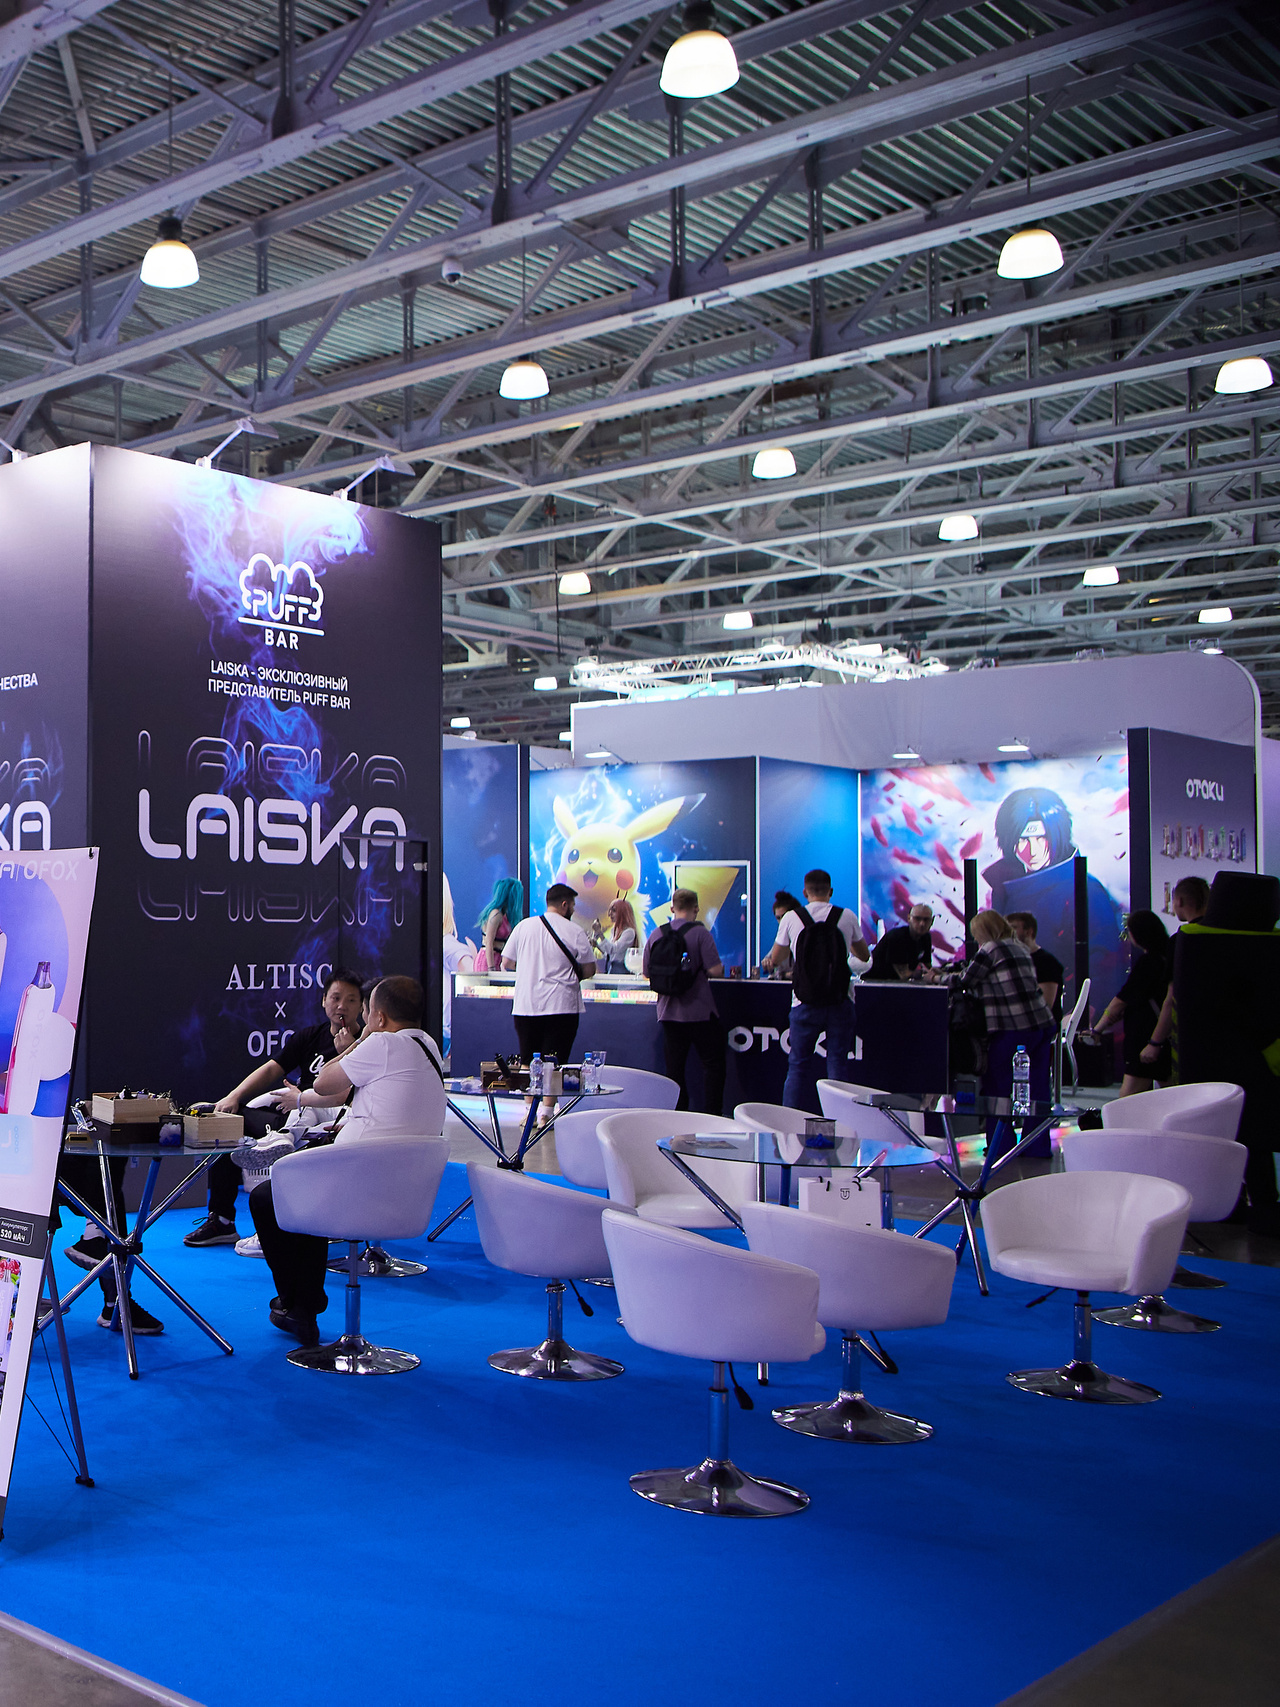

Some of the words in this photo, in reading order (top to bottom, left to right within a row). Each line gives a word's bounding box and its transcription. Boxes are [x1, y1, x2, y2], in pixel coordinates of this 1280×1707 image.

[253, 589, 312, 624] PUFF
[265, 629, 299, 650] BAR
[211, 659, 249, 678] LAISKA
[257, 666, 348, 692] ЭКСКЛЮЗИВНЫЙ
[208, 678, 301, 703] ПРЕДСТАВИТЕЛЬ
[303, 691, 329, 707] PUFF
[330, 694, 351, 710] BAR
[138, 788, 407, 872] LAISKA
[24, 859, 79, 881] OFOX
[0, 1229, 12, 1239] 520
